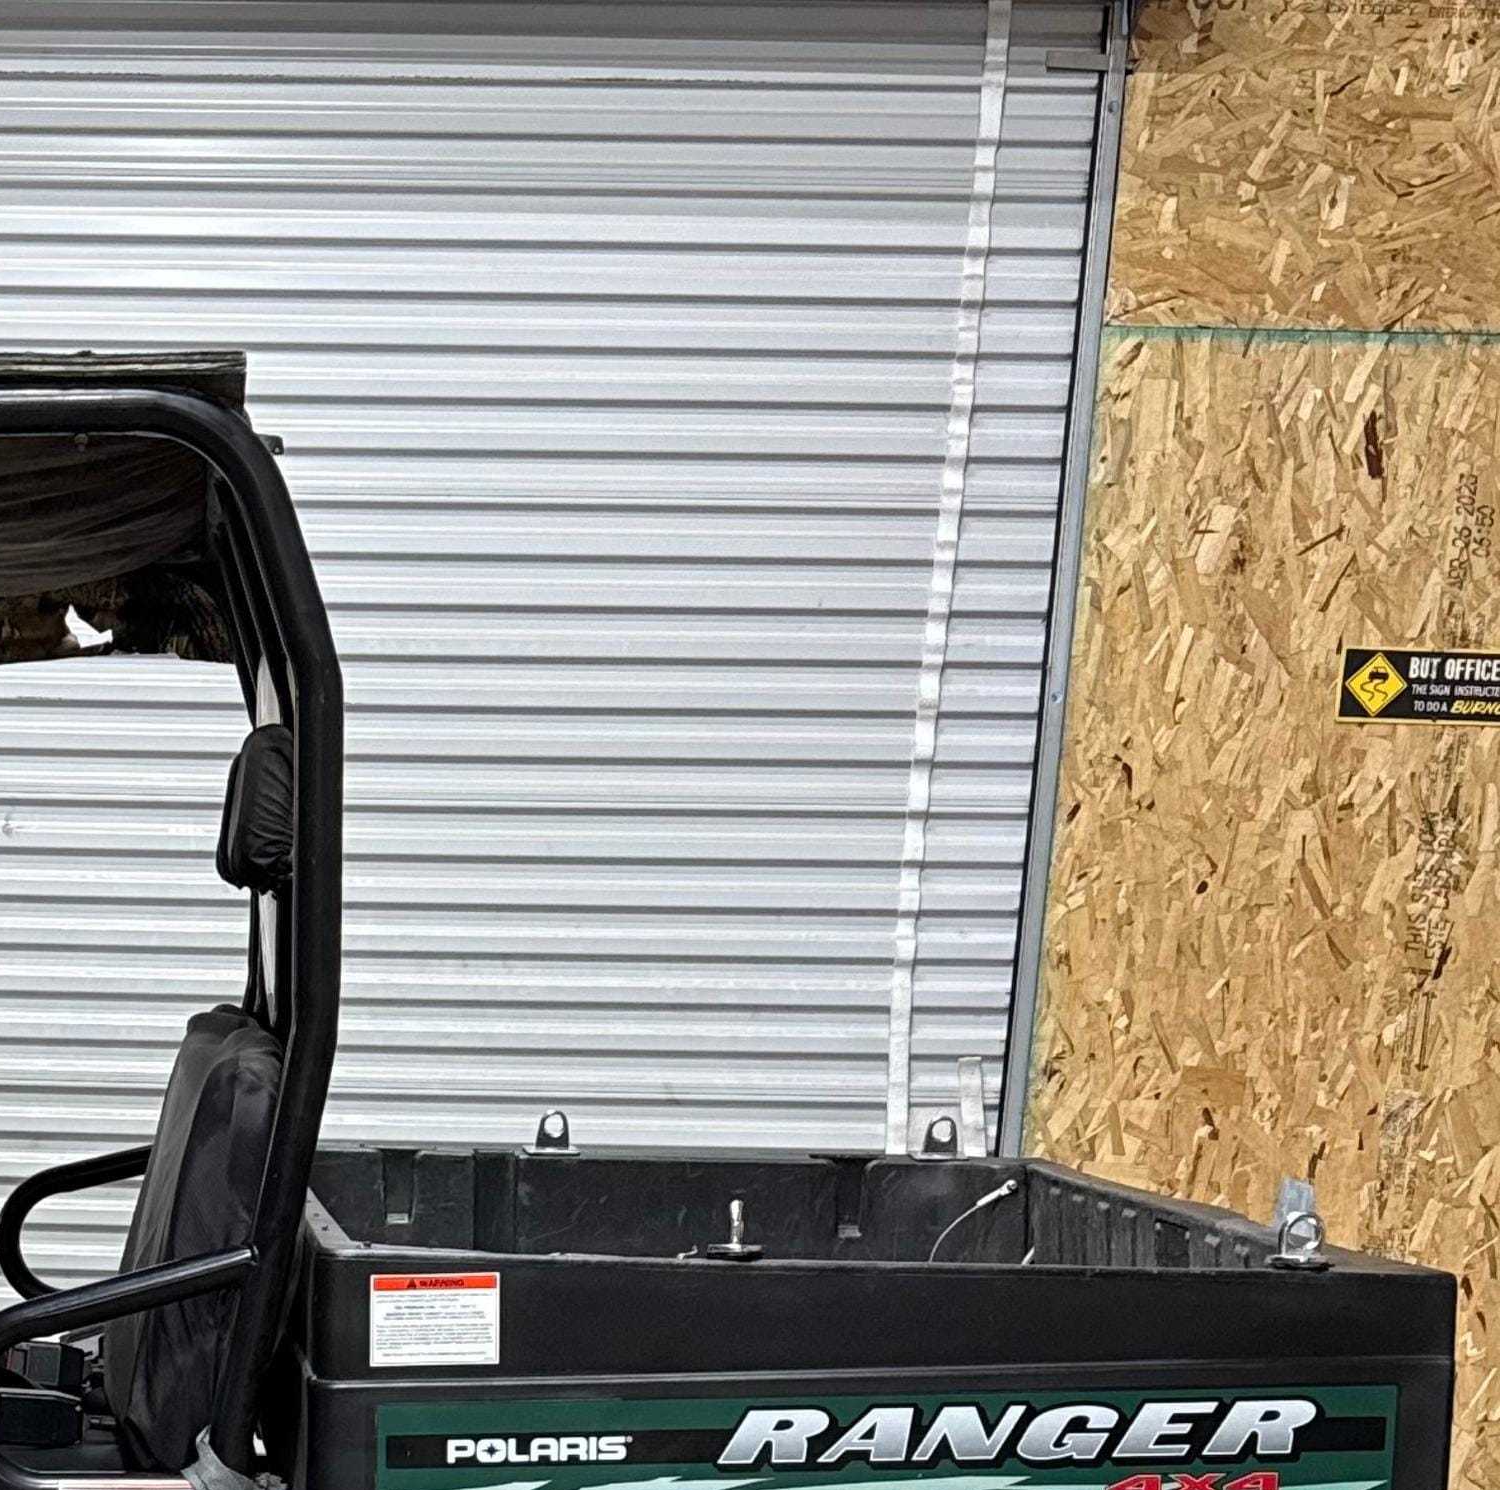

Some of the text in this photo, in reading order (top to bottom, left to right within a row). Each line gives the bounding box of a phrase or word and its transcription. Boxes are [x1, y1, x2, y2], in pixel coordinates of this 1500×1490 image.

[1408, 656, 1442, 680] BUT
[1412, 683, 1428, 696] THE
[1429, 684, 1451, 697] SIGN
[1414, 700, 1425, 712] TO
[1426, 701, 1440, 712] DO
[1441, 701, 1448, 713] A
[419, 1279, 465, 1288] WARNING
[446, 1399, 1318, 1464] POLARIS RANGER
